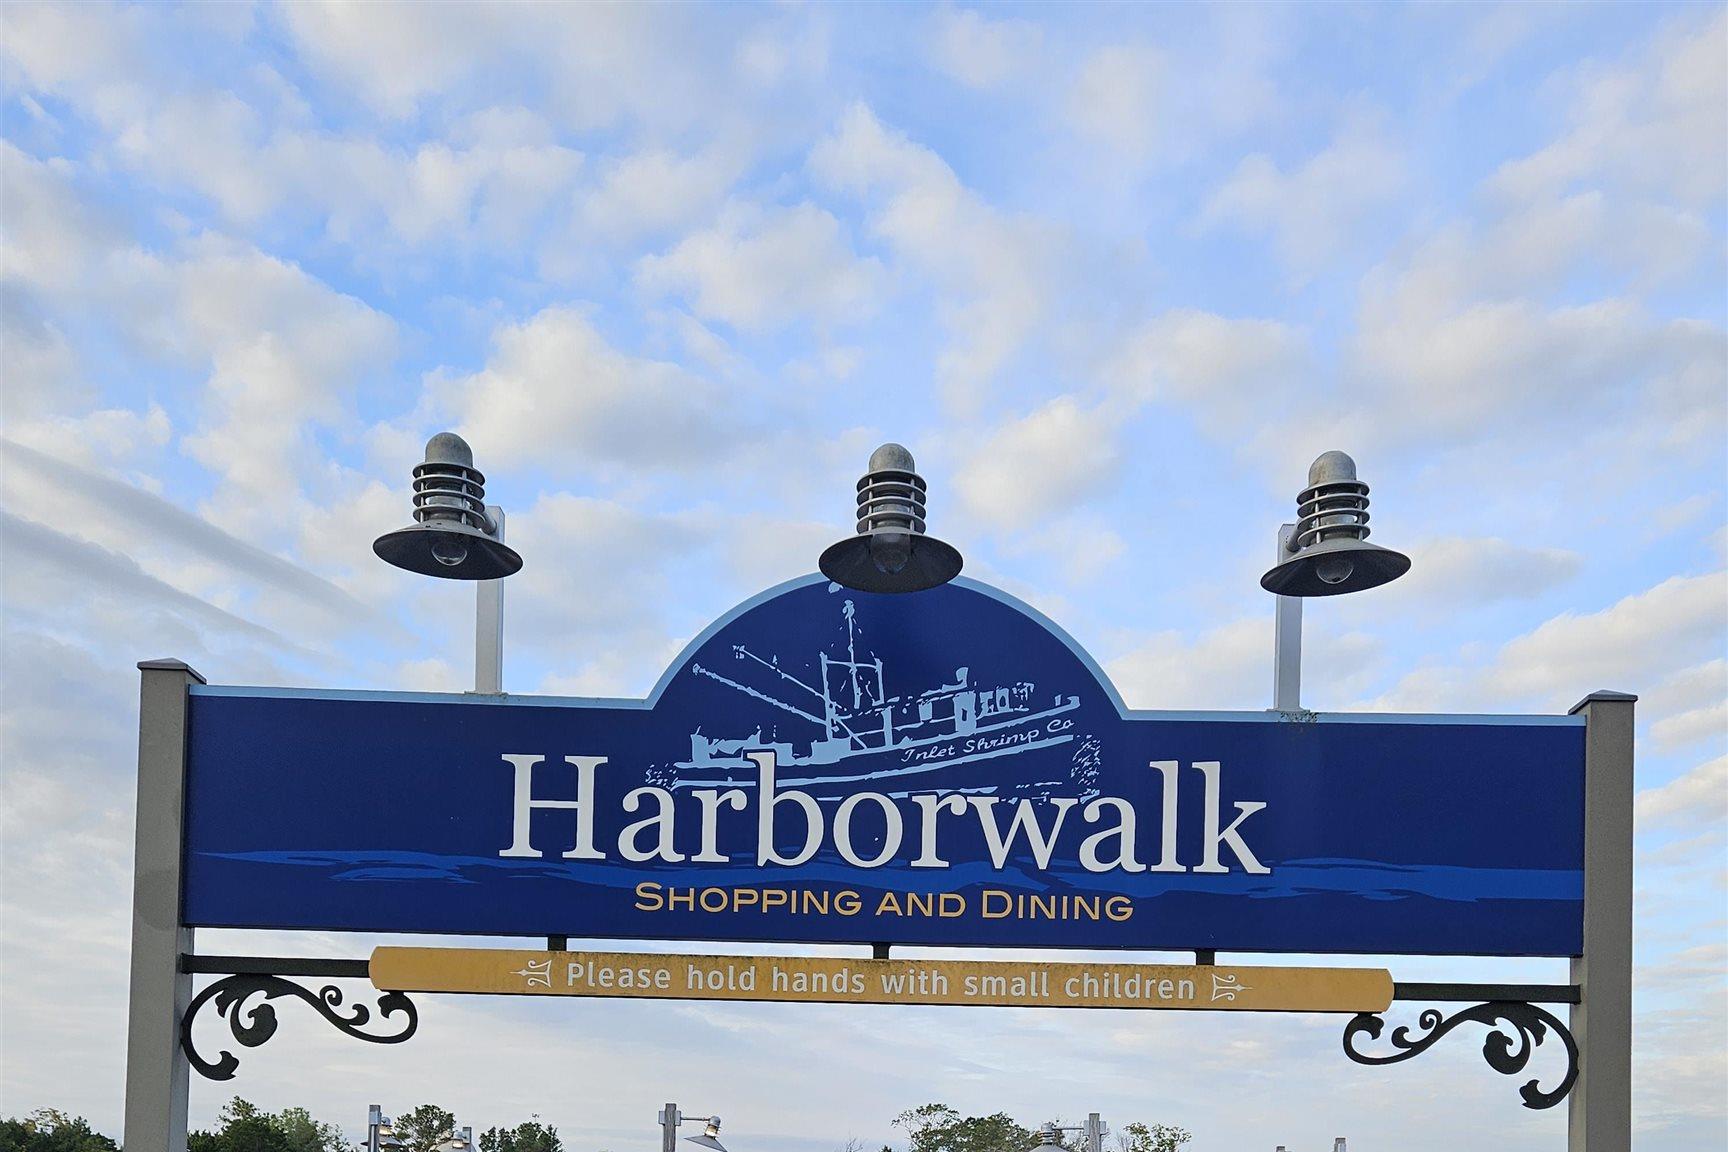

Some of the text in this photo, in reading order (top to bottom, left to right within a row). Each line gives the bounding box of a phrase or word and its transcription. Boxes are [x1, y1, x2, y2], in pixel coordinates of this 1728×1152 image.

[901, 718, 1075, 763] Inlet Shrimp Co
[499, 752, 1271, 874] Harborwalk
[566, 961, 1196, 1001] Please hold hands with small children
